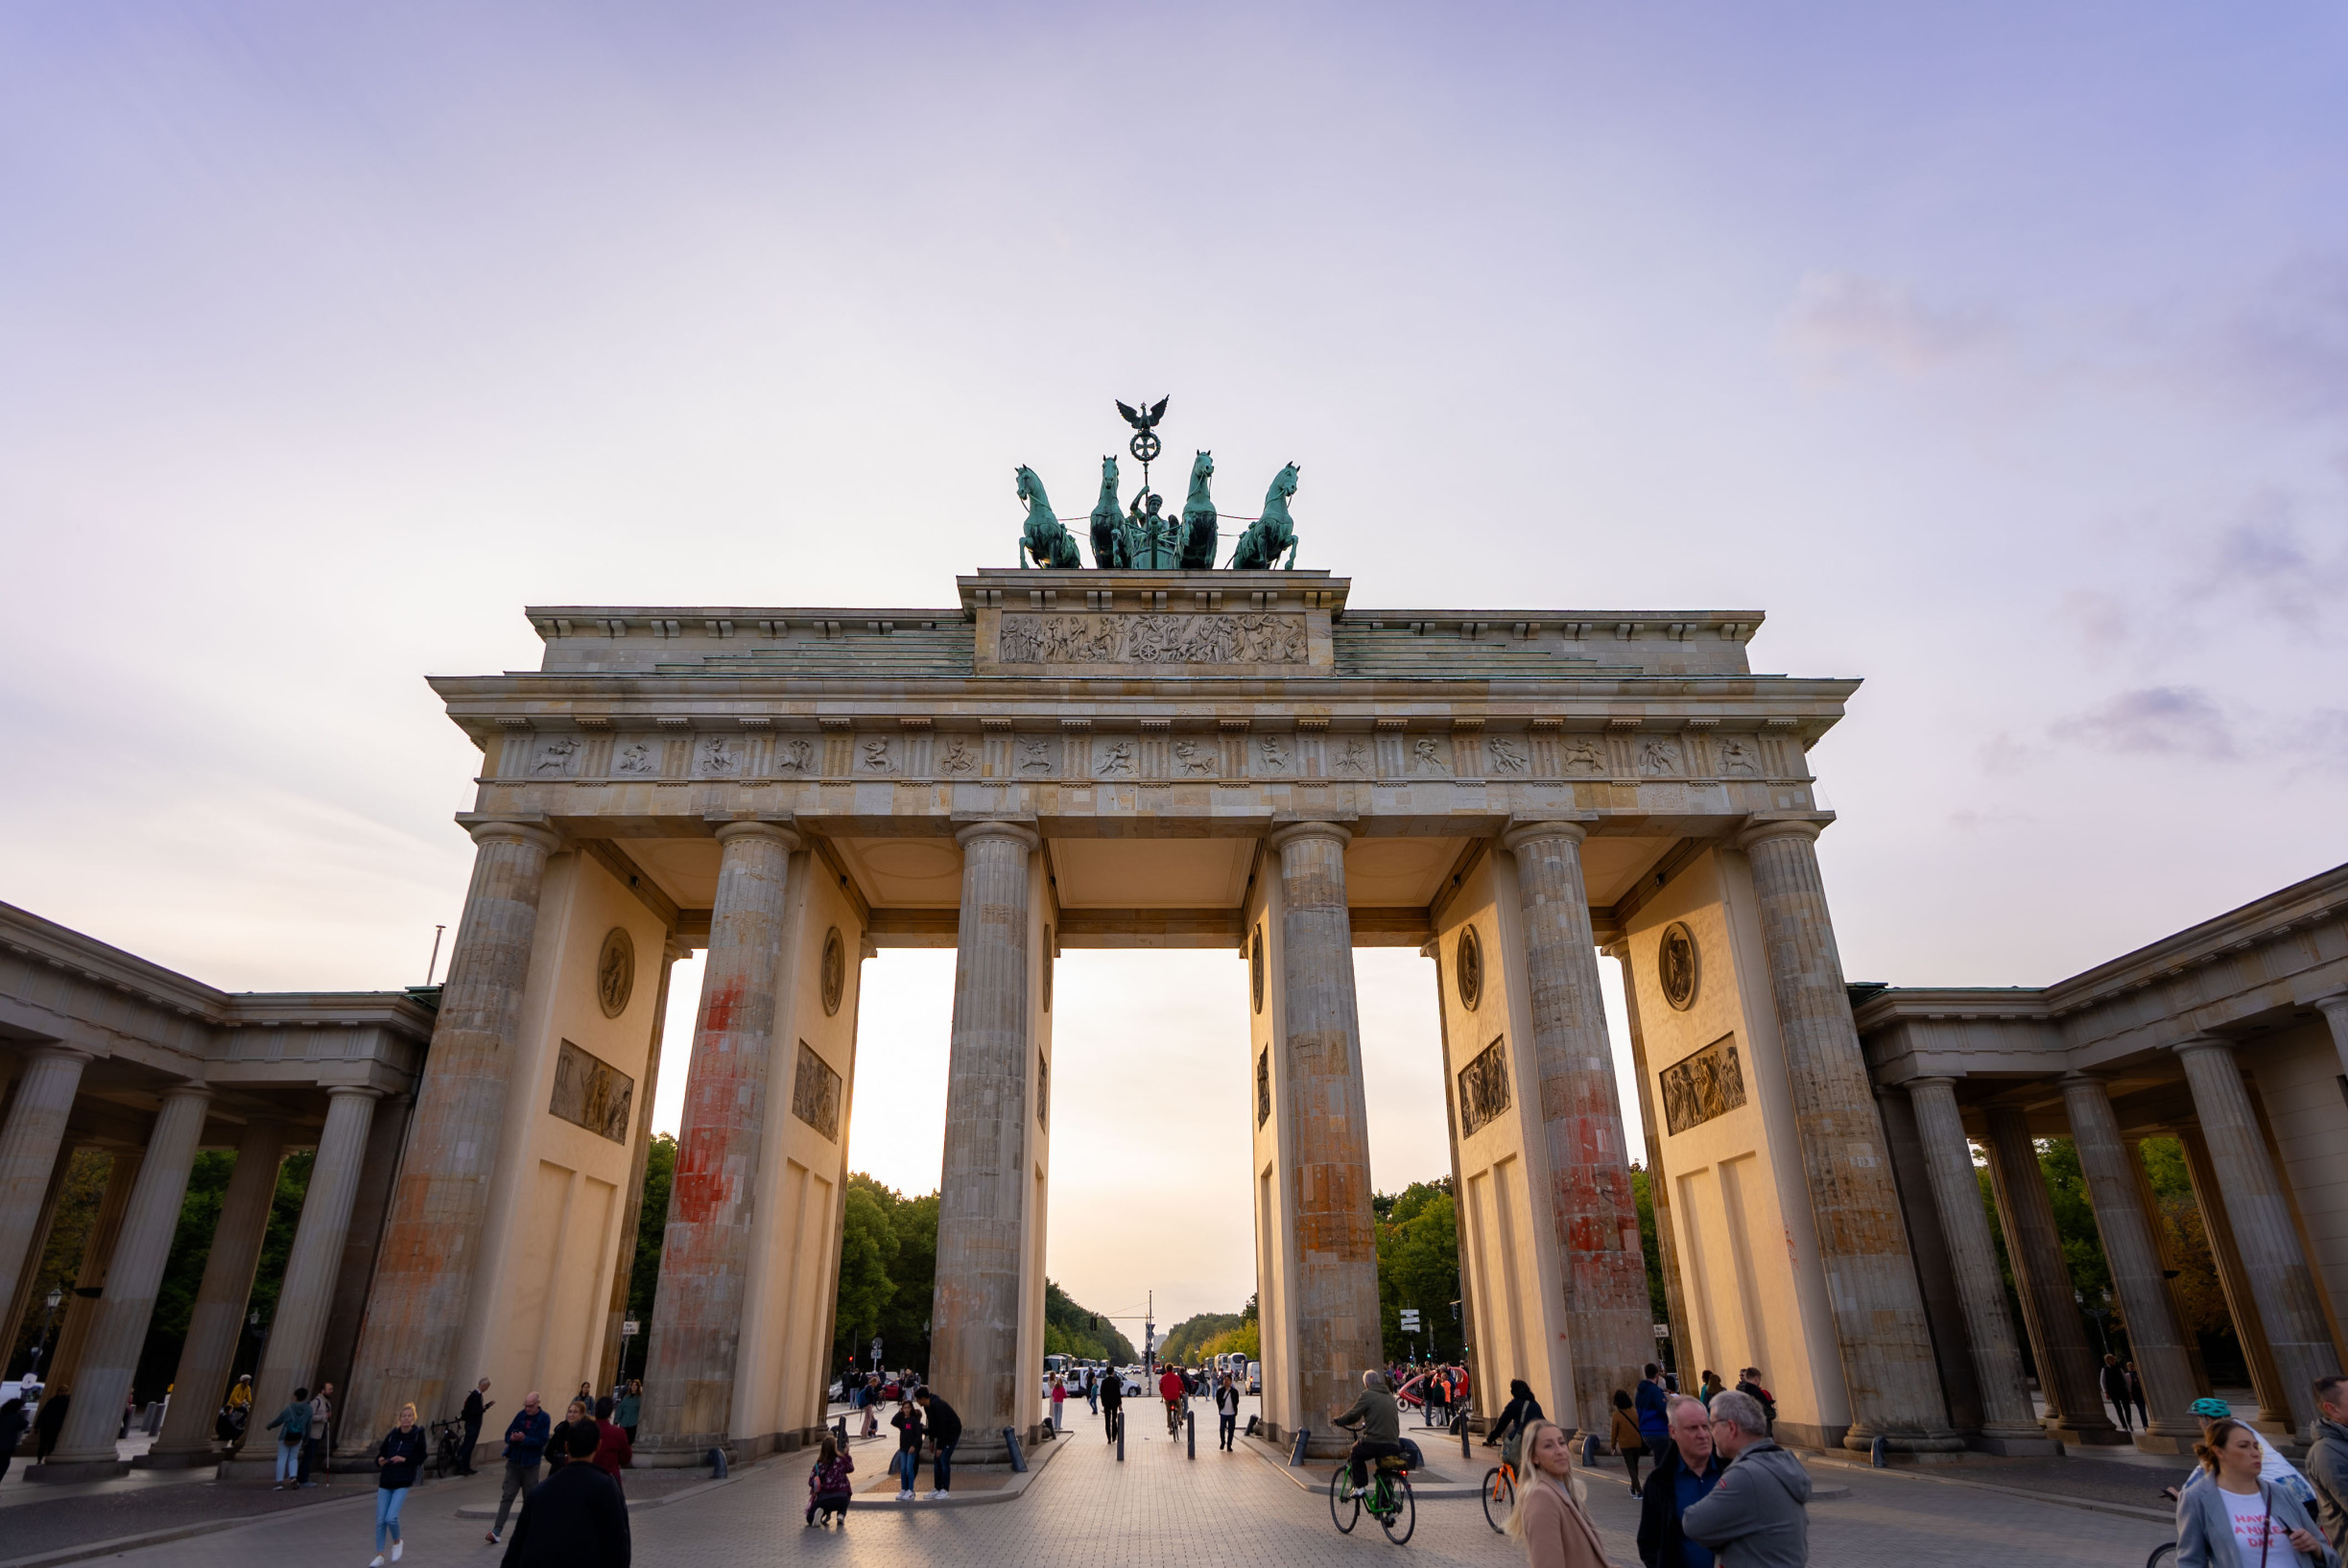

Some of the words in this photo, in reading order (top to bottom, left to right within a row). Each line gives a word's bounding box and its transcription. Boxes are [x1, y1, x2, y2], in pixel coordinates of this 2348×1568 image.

[2235, 1526, 2246, 1534] A
[2246, 1526, 2281, 1535] NIE
[2247, 1538, 2273, 1548] DAY
